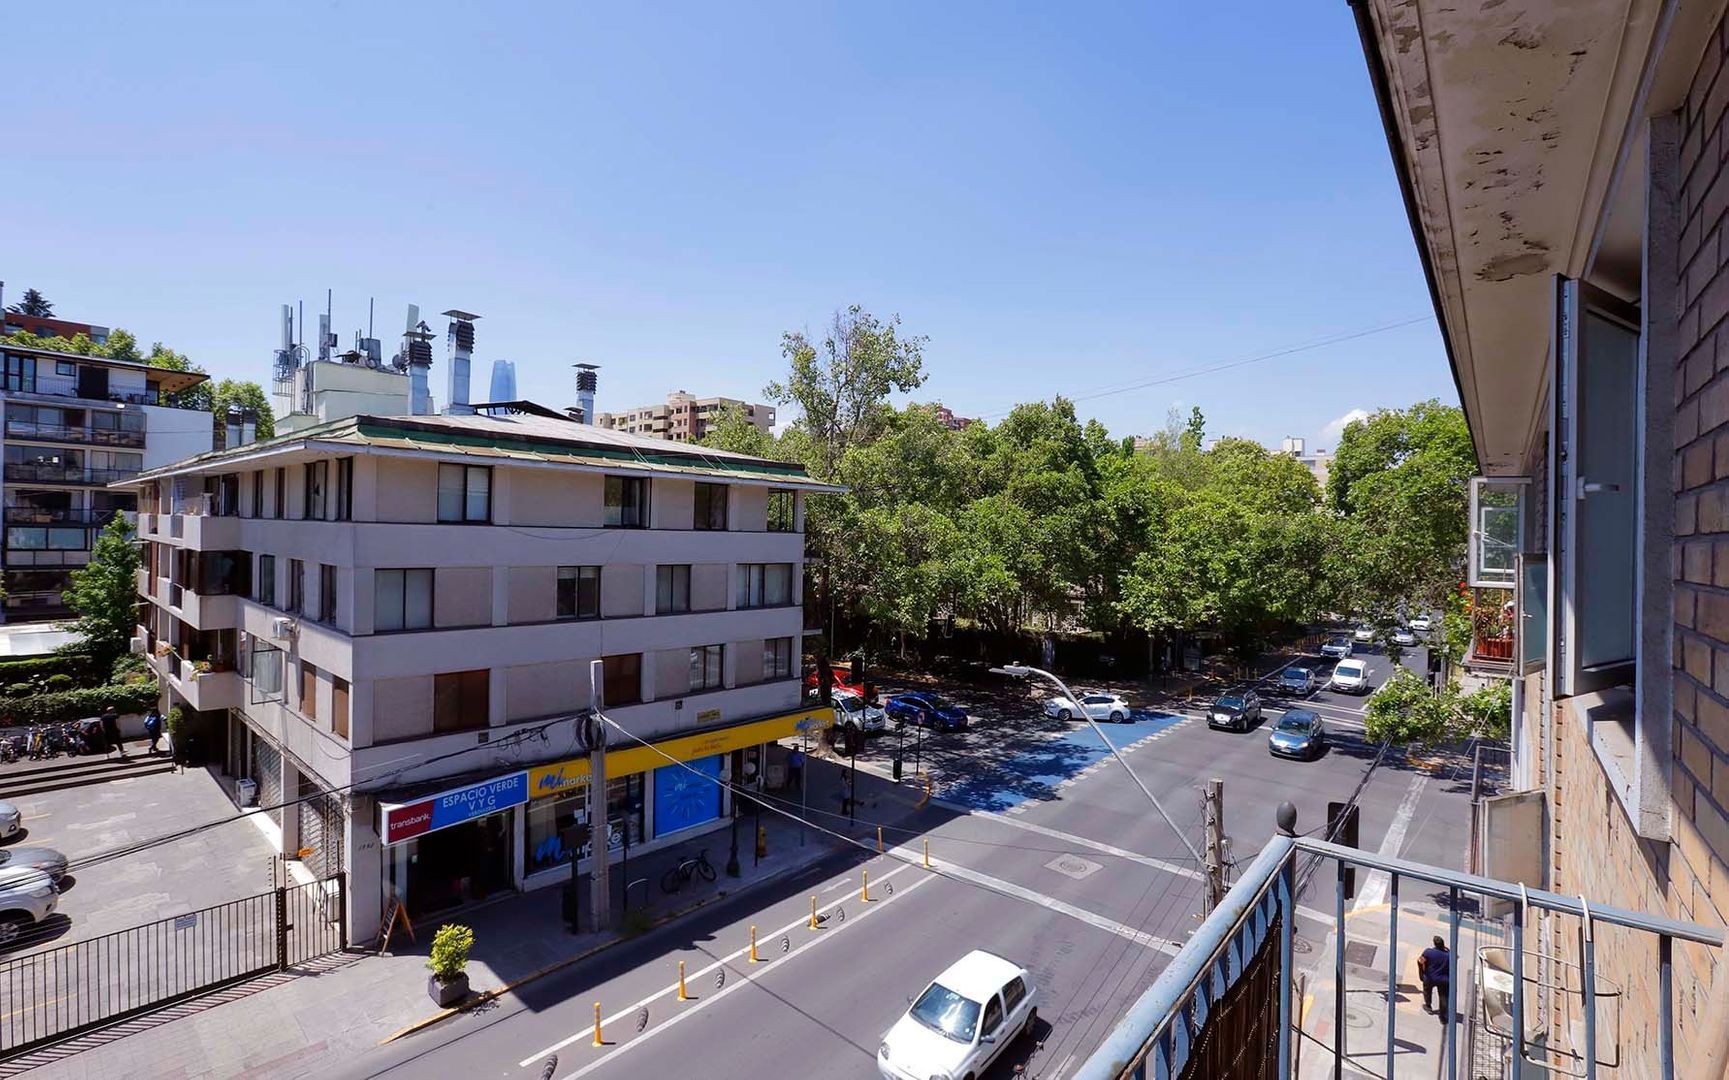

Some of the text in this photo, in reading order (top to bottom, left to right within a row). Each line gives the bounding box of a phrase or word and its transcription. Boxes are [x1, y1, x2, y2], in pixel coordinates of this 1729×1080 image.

[560, 774, 593, 788] marke
[442, 777, 519, 808] ESPACIO VERDE
